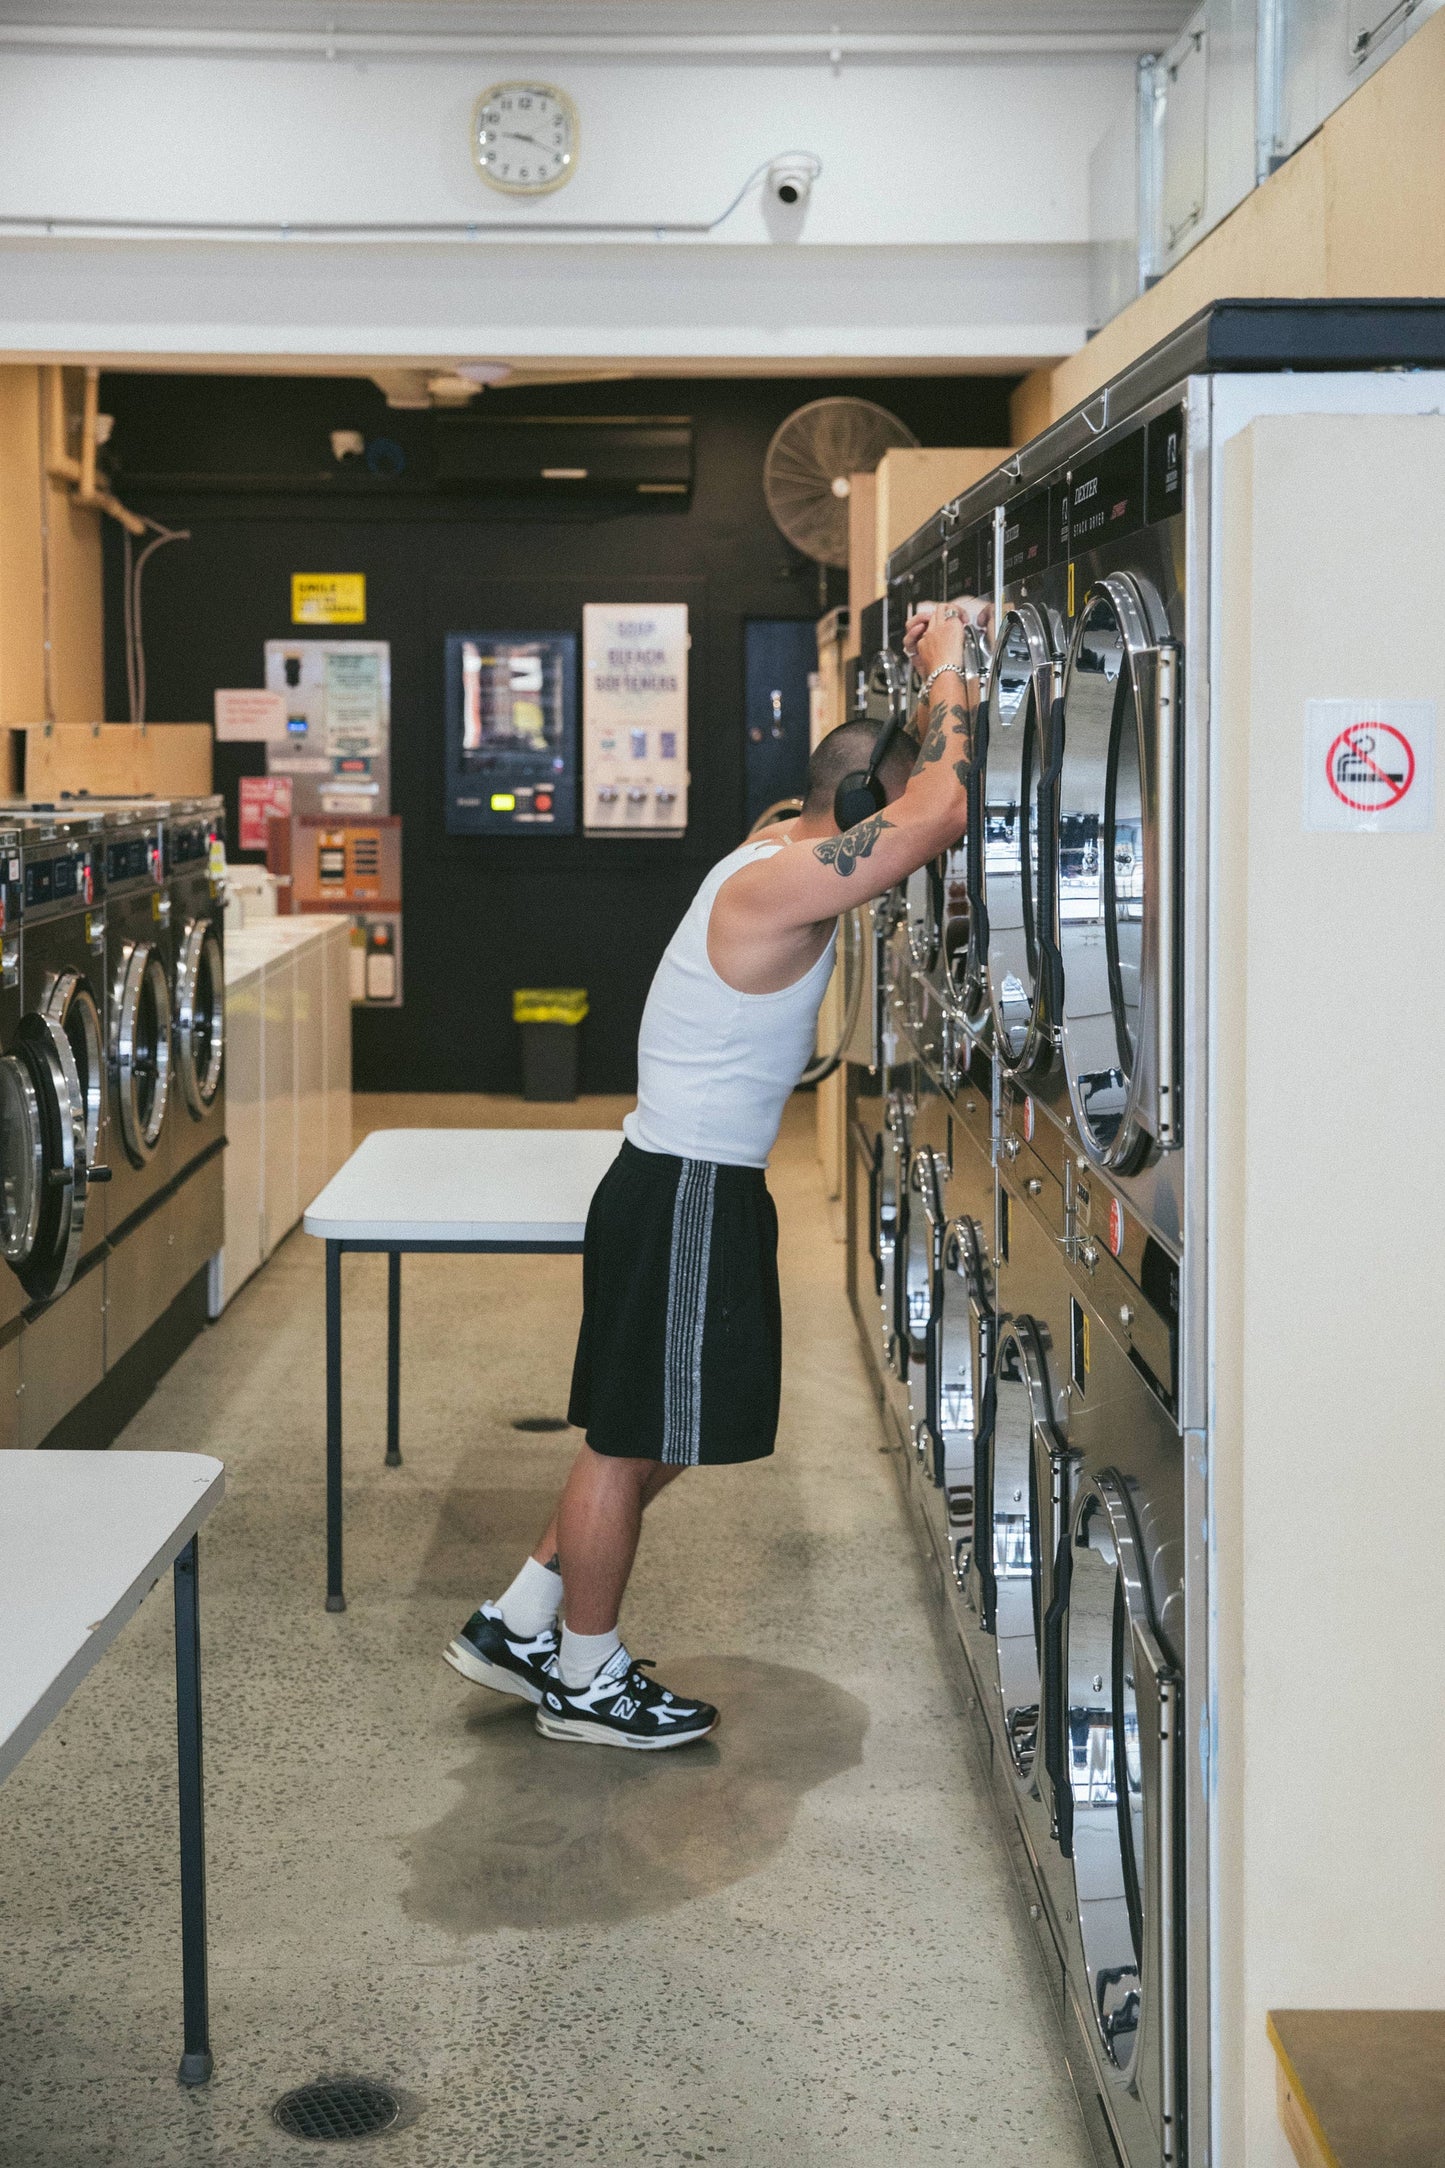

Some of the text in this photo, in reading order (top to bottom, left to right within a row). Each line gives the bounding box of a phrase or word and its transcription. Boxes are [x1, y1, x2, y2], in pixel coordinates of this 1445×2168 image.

[1074, 477, 1098, 505] DEXTER
[1073, 519, 1087, 537] STACK
[1089, 511, 1104, 530] DRYER
[618, 620, 656, 637] SOAP
[609, 648, 664, 666] BLEACH
[595, 675, 677, 693] SOFTENERS
